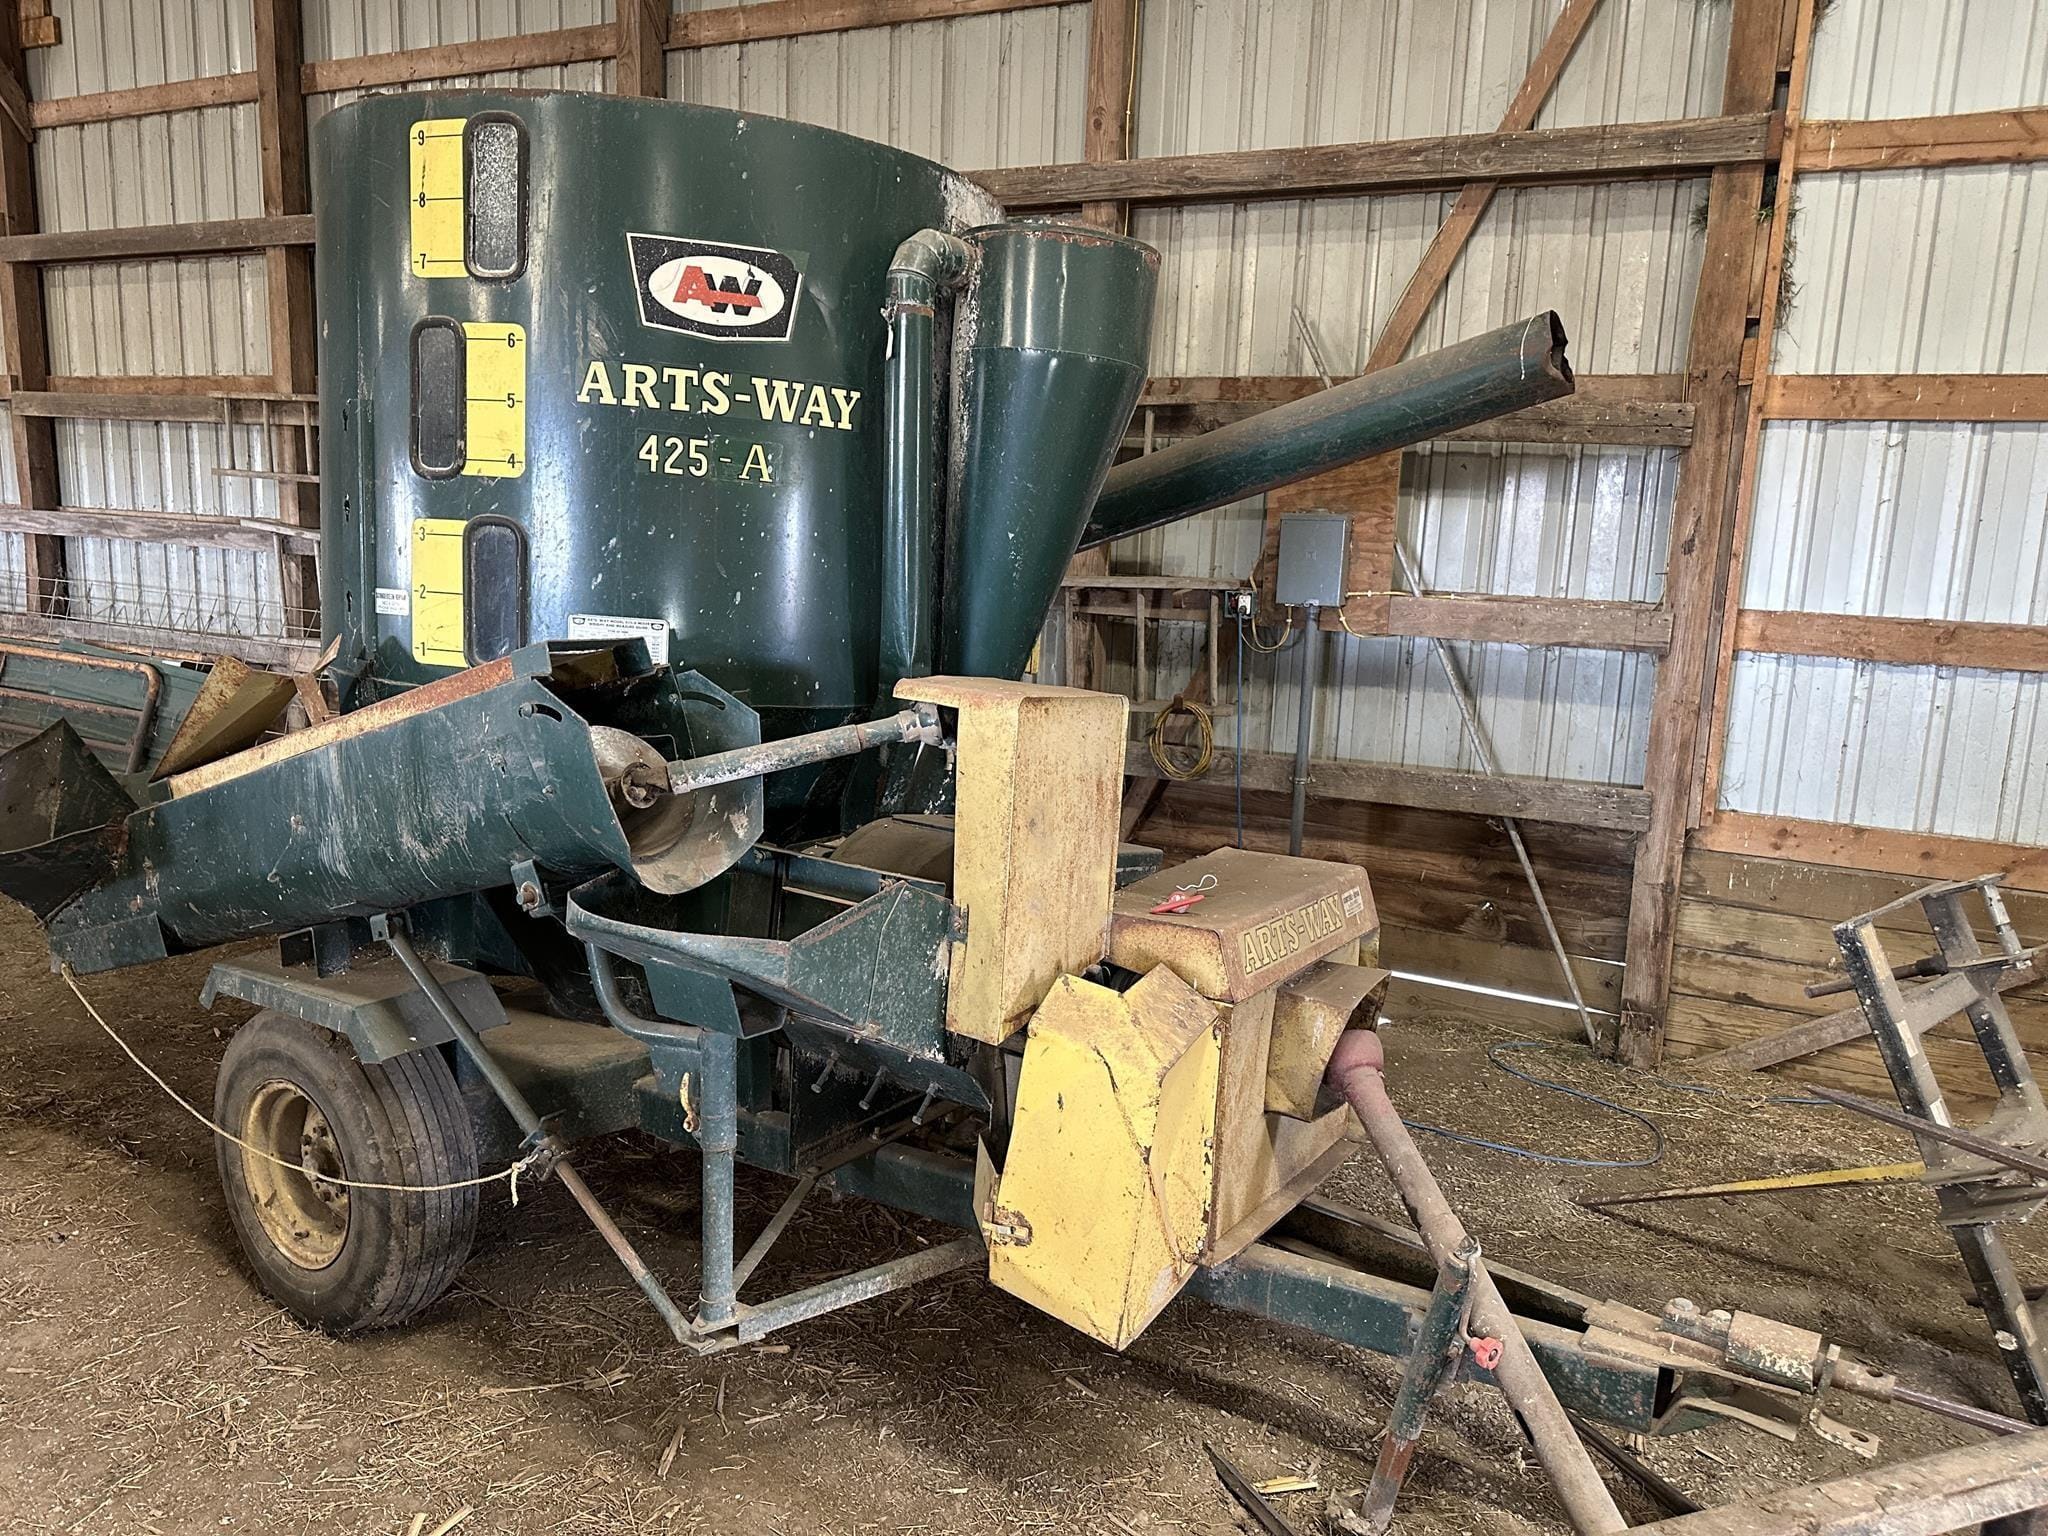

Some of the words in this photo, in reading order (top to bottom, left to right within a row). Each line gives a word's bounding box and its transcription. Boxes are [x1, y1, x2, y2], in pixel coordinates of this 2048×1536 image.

[417, 129, 425, 146] 9
[418, 191, 426, 208] 8
[418, 253, 427, 270] 7
[507, 332, 516, 349] 6
[507, 392, 516, 409] 5
[507, 452, 516, 469] 4
[419, 526, 426, 542] 3
[419, 584, 427, 600] 2
[420, 641, 426, 657] 1
